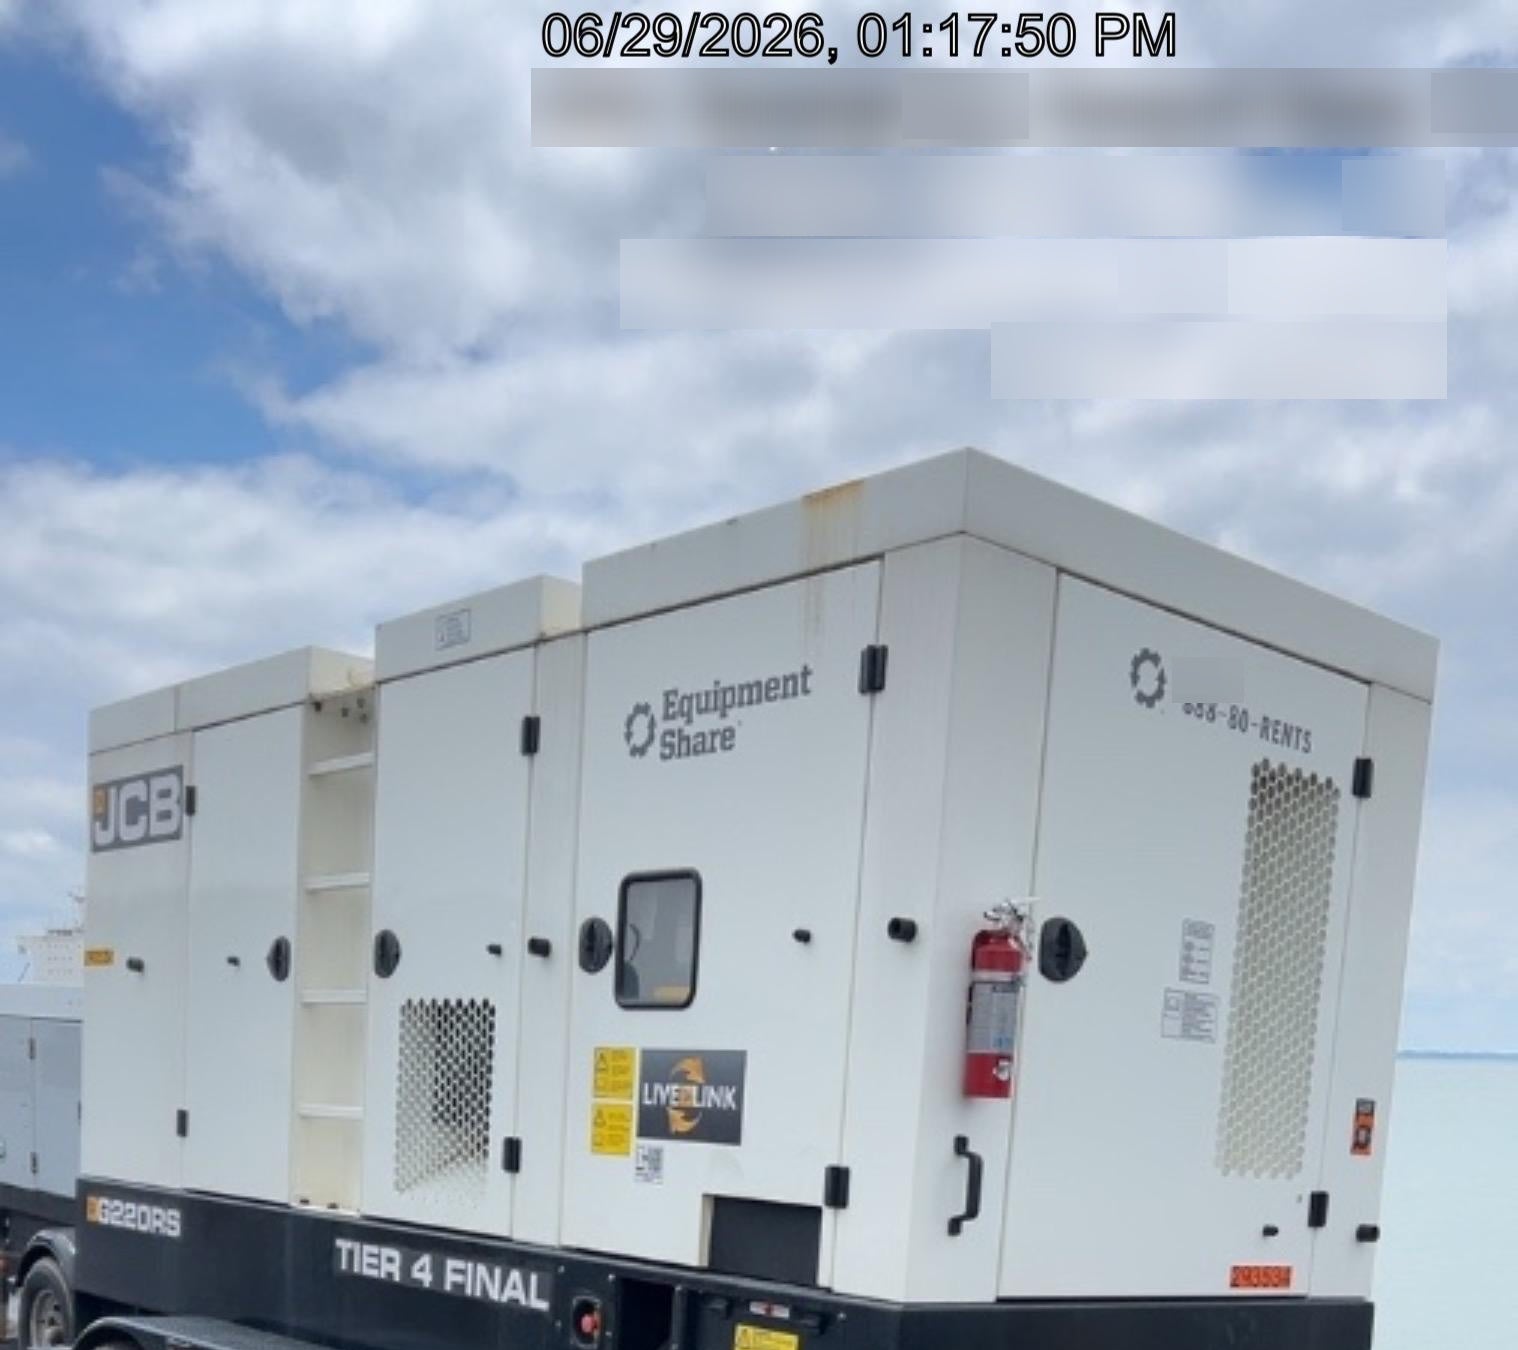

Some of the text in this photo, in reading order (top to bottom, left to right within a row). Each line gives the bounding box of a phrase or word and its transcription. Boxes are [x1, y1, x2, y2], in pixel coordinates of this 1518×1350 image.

[661, 664, 812, 724] Equipment
[659, 725, 736, 761] Share
[94, 773, 181, 846] JCB
[335, 1238, 549, 1312] TIER 4 FINAL
